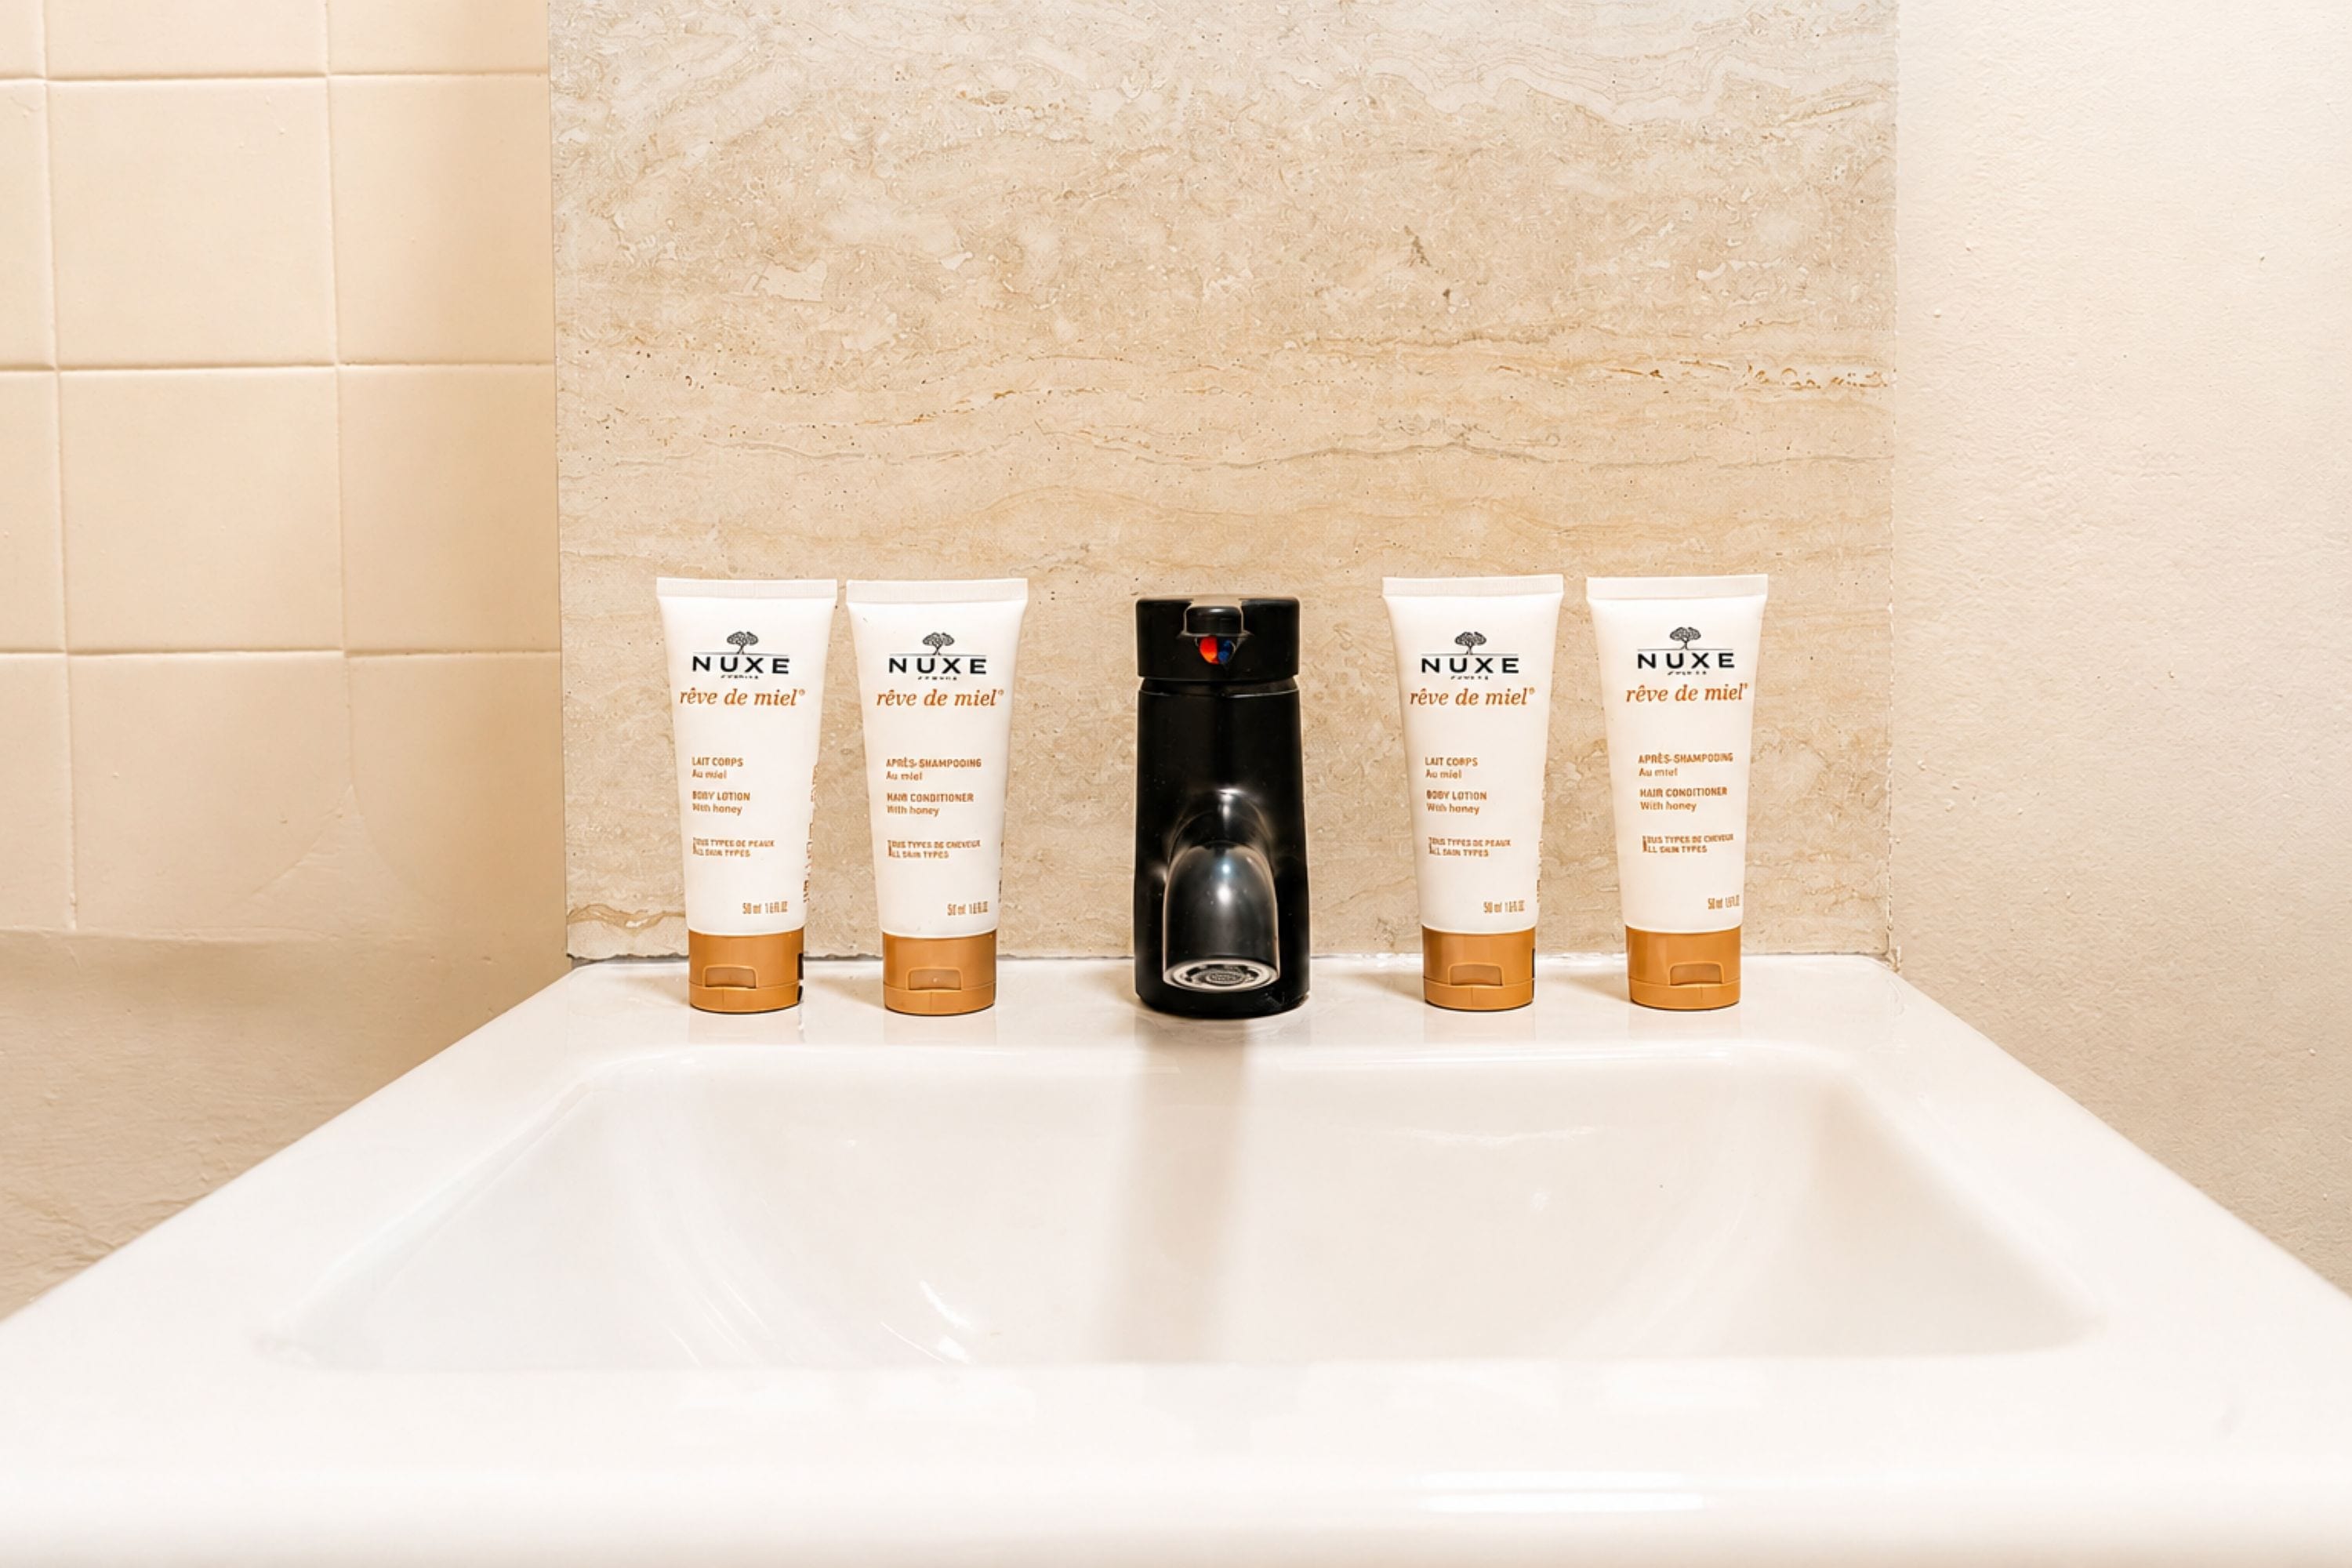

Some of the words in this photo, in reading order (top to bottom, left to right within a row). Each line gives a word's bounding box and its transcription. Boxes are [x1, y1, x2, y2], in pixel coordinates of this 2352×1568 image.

[692, 656, 789, 674] NUXE
[889, 658, 986, 674] NUXE
[1421, 658, 1519, 673] NUXE
[1638, 653, 1735, 669] NUXE
[680, 687, 718, 704] rêve
[724, 688, 748, 706] de
[877, 689, 917, 706] rêve
[924, 688, 948, 706] de
[1410, 688, 1449, 706] rêve
[1455, 688, 1479, 706] de
[1625, 684, 1668, 702] rêve
[1675, 684, 1698, 702] de
[691, 757, 710, 766] LAIT
[713, 757, 743, 767] CORPS
[1425, 757, 1443, 766] LAIT
[1446, 757, 1478, 767] CORPS
[691, 769, 702, 779] Au
[886, 771, 897, 780] Au
[1425, 769, 1437, 779] Au
[1440, 769, 1462, 779] miel
[1639, 768, 1652, 776] Au
[692, 790, 714, 800] BODY
[717, 792, 750, 801] LOTION
[1426, 789, 1450, 800] BODY
[1452, 791, 1487, 800] LOTION
[1640, 788, 1663, 797] HAIR
[1665, 786, 1727, 797] CONDITIONER
[887, 793, 907, 801] HAIR
[910, 793, 974, 802] CONDITIONER
[692, 803, 710, 812] With
[713, 804, 742, 816] honey
[887, 805, 907, 814] With
[909, 805, 939, 817] honey
[1426, 803, 1447, 812] With
[1450, 804, 1480, 815] honey
[1640, 801, 1663, 810] With
[1665, 801, 1697, 811] honey
